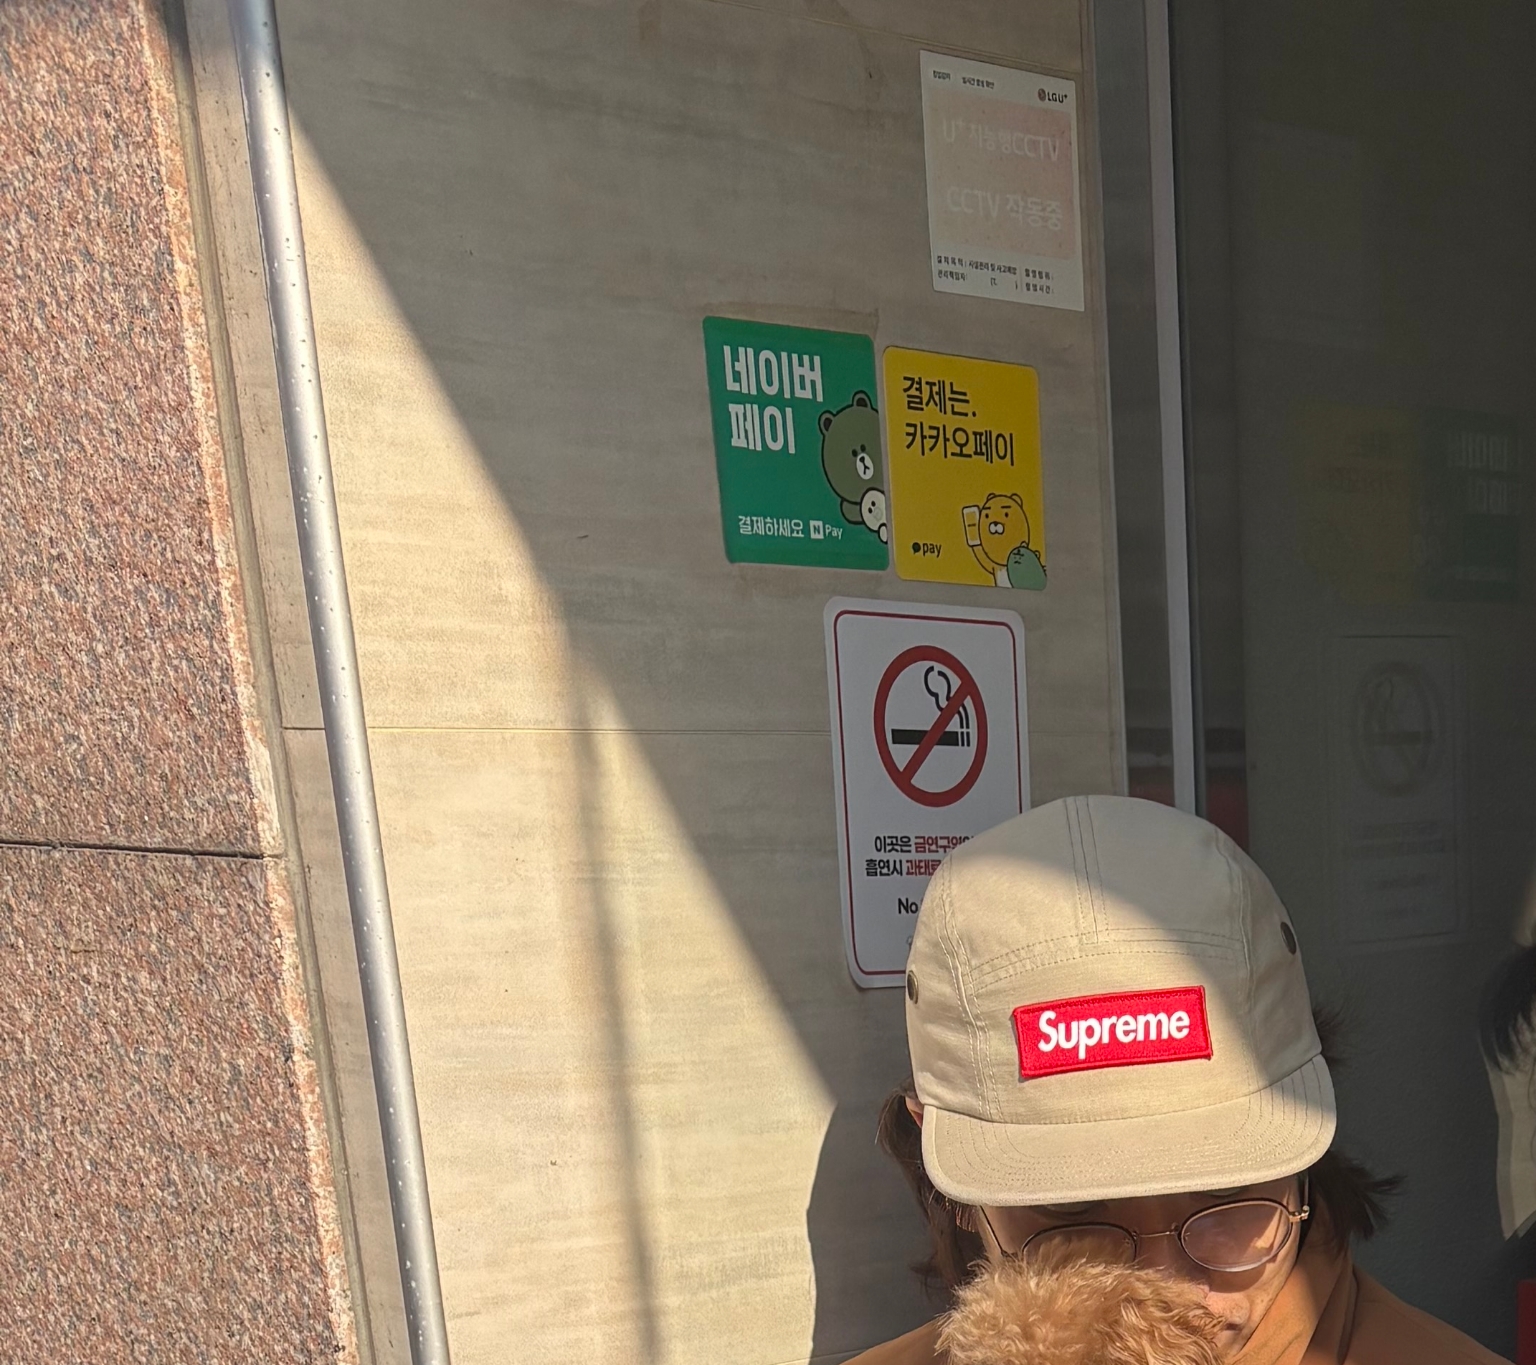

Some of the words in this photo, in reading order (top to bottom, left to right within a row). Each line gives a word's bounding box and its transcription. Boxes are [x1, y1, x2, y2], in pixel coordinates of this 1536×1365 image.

[948, 186, 1000, 219] CCTV
[1005, 194, 1064, 231] 작동중
[723, 345, 824, 402] 네이버
[728, 403, 796, 455] 페이
[905, 421, 1015, 467] 카카오페이
[738, 515, 805, 539] 결제하세요
[825, 525, 843, 540] Pay
[922, 543, 942, 558] pay
[874, 835, 912, 853] 이곳은
[865, 859, 903, 877] 흡연시
[898, 897, 919, 915] No
[1036, 1008, 1191, 1059] Supreme
